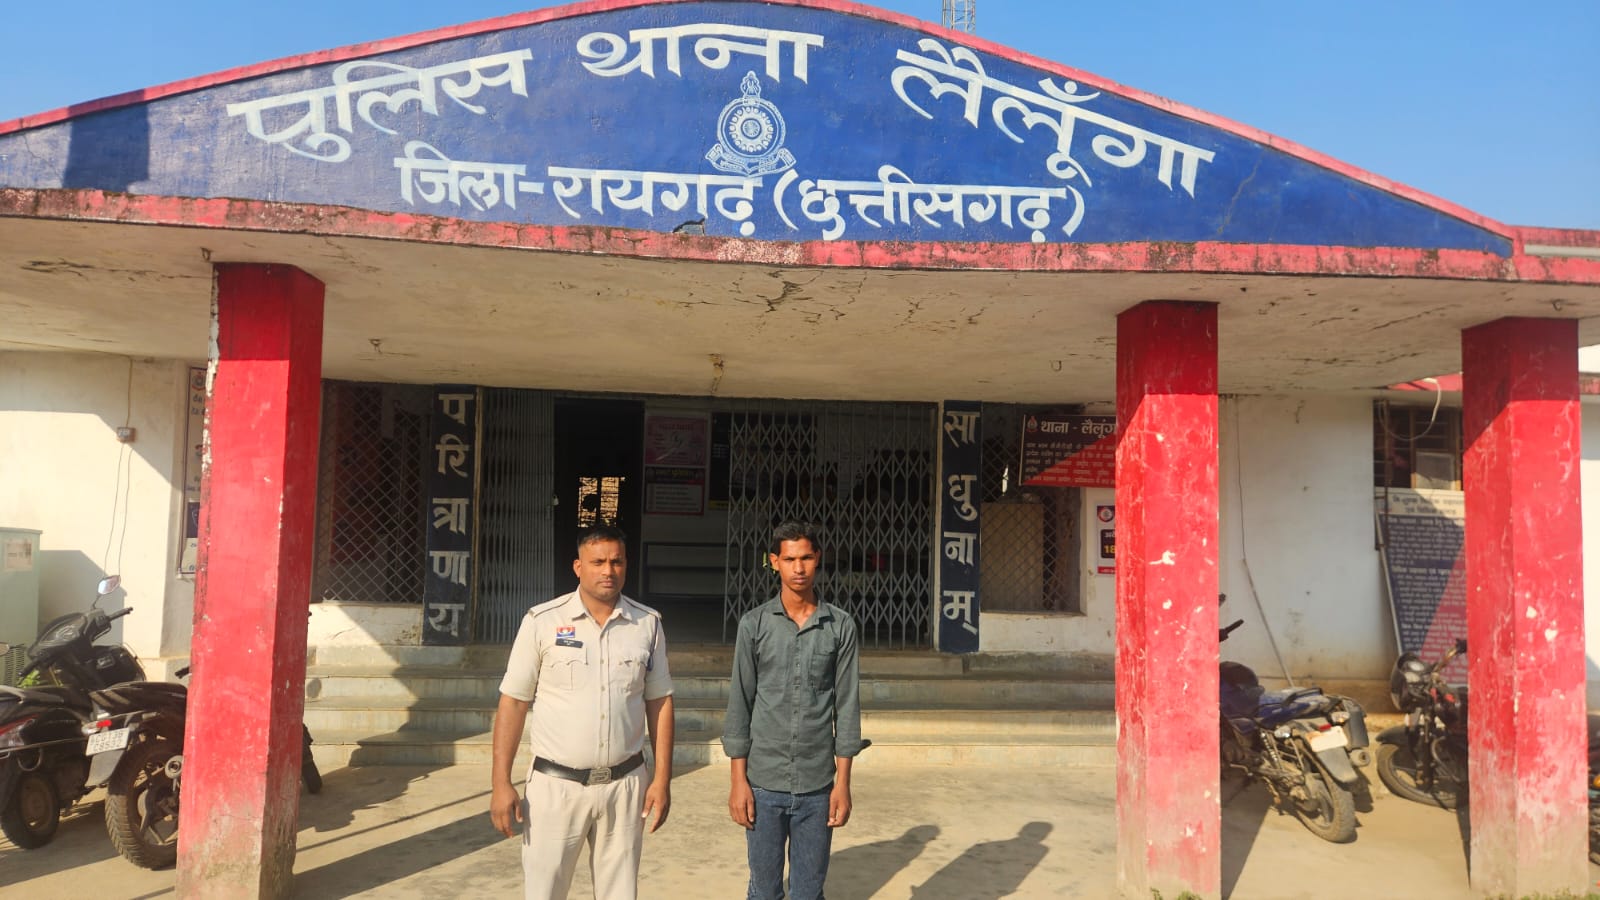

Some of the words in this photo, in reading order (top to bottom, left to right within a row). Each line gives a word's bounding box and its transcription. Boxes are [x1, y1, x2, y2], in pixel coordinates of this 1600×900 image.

[227, 48, 533, 164] पुलिस
[577, 23, 824, 84] थाना
[1040, 420, 1070, 434] थाना
